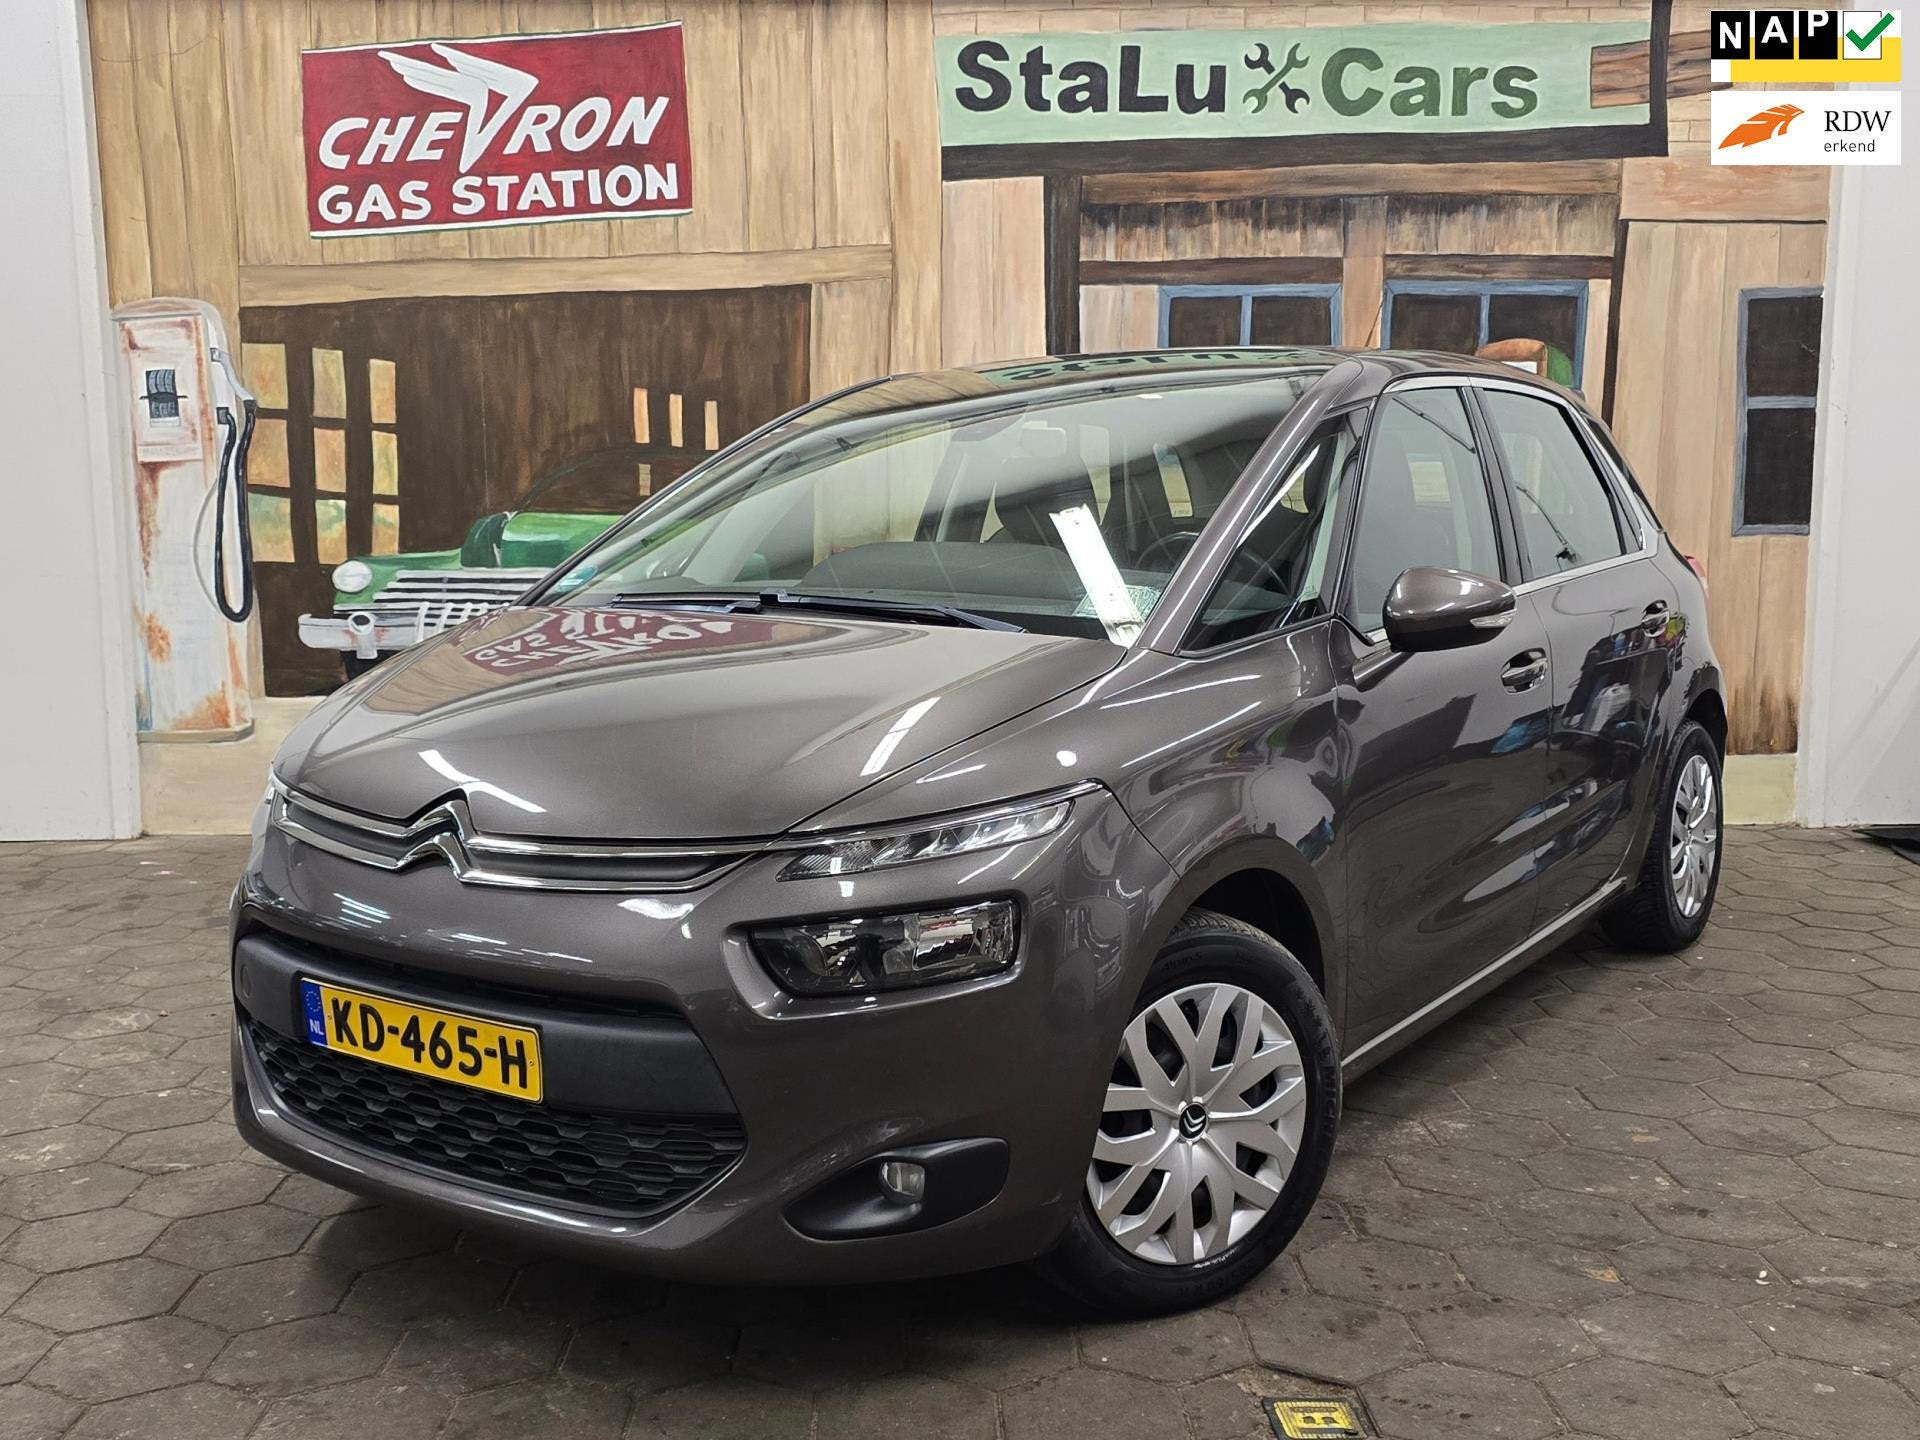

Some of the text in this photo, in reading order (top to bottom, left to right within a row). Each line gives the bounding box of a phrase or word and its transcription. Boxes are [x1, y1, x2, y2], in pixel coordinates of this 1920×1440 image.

[954, 40, 1539, 119] StaLu Cars
[318, 80, 670, 173] CHEVRON
[318, 163, 678, 224] GAS STATION
[309, 1018, 325, 1036] NL
[331, 997, 528, 1089] KD-465-H
